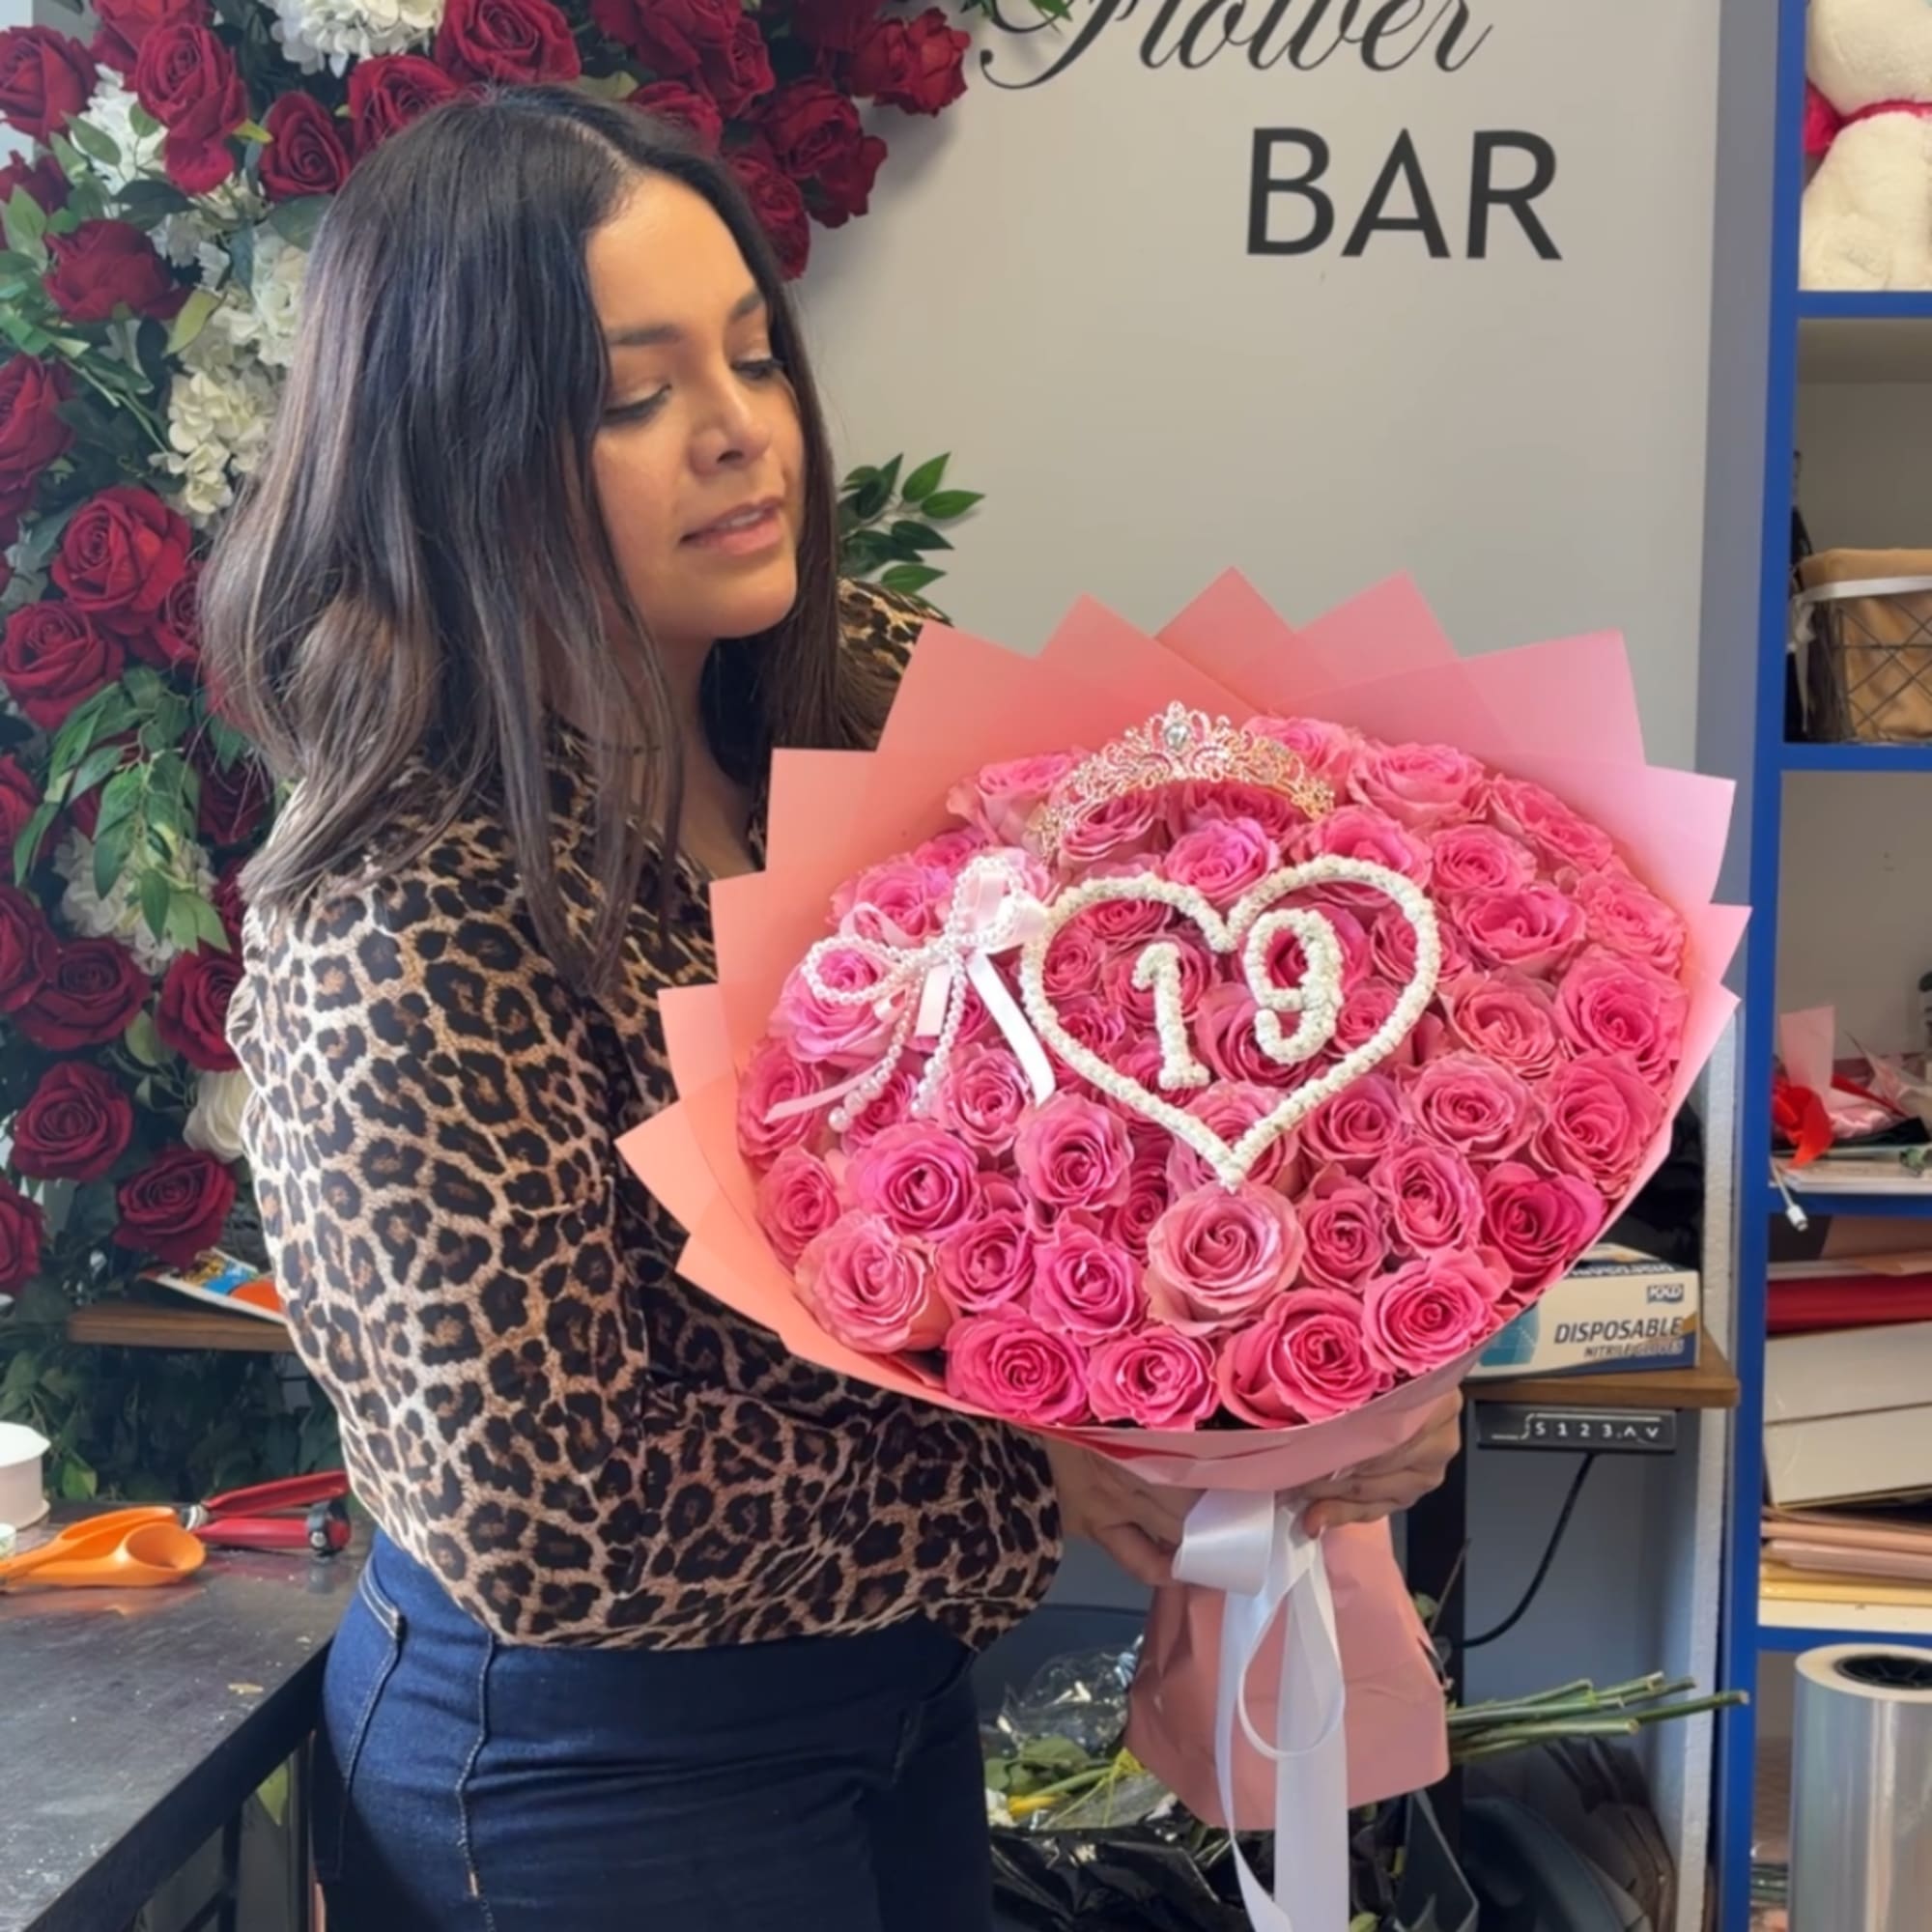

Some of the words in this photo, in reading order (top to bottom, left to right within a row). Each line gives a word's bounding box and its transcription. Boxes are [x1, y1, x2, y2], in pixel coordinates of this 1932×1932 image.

[1247, 128, 1562, 260] BAR
[1131, 908, 1344, 1091] 19
[1554, 1317, 1683, 1344] DISPOSABLE
[1558, 1422, 1568, 1436] 1
[1579, 1423, 1590, 1437] 2
[1602, 1424, 1612, 1437] 3
